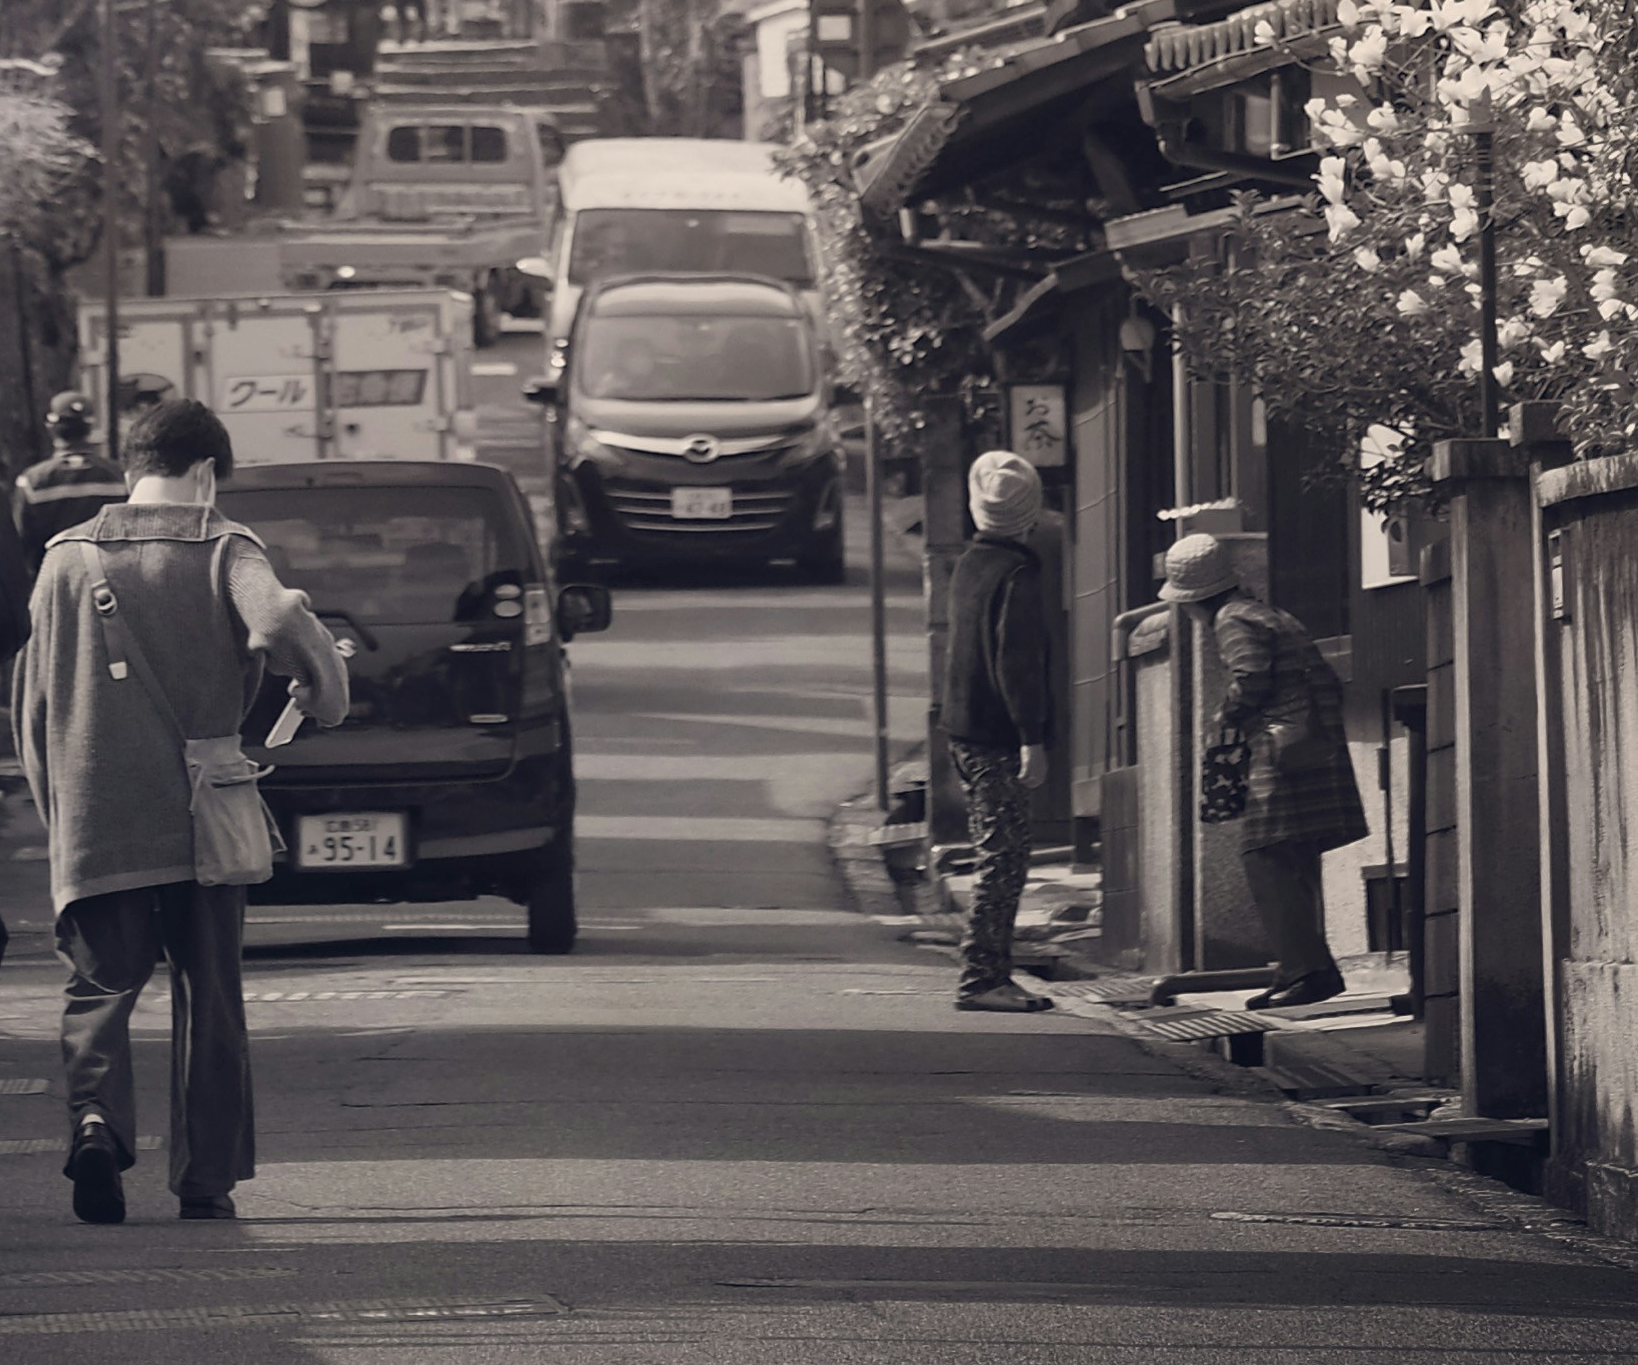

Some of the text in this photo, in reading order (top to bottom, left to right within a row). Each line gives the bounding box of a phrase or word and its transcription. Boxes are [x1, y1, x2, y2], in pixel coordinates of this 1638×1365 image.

[229, 376, 307, 407] クール
[1024, 396, 1063, 451] お茶
[323, 835, 397, 861] 95-14
